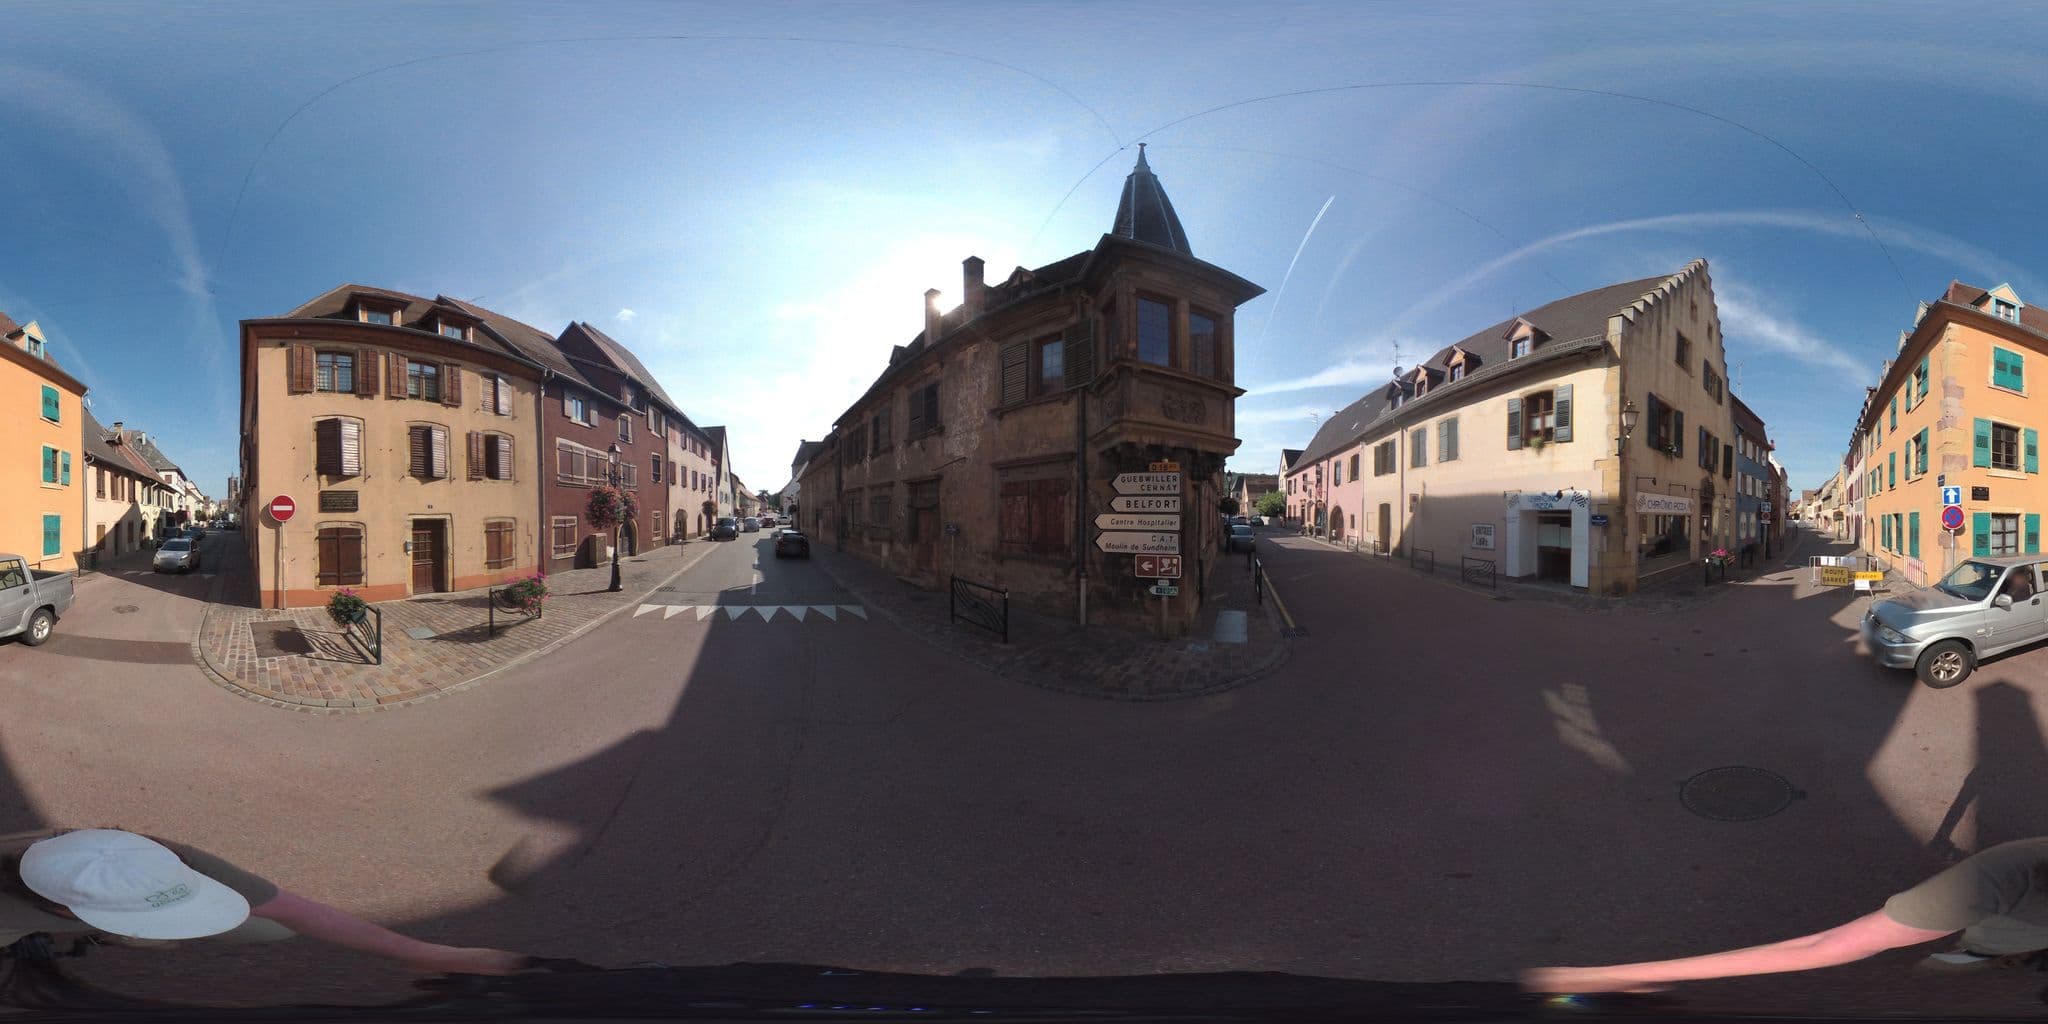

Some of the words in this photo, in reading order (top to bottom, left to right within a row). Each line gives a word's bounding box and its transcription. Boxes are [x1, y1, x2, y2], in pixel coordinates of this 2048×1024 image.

[1120, 475, 1178, 483] GUEBWILLER
[1140, 484, 1177, 492] CERNAY
[1125, 499, 1177, 509] BELFORT
[1110, 518, 1134, 526] Centre
[1136, 518, 1177, 527] Hospitalier
[1104, 543, 1128, 551] Moulin
[1130, 543, 1139, 551] de
[1142, 543, 1177, 552] Sundheim
